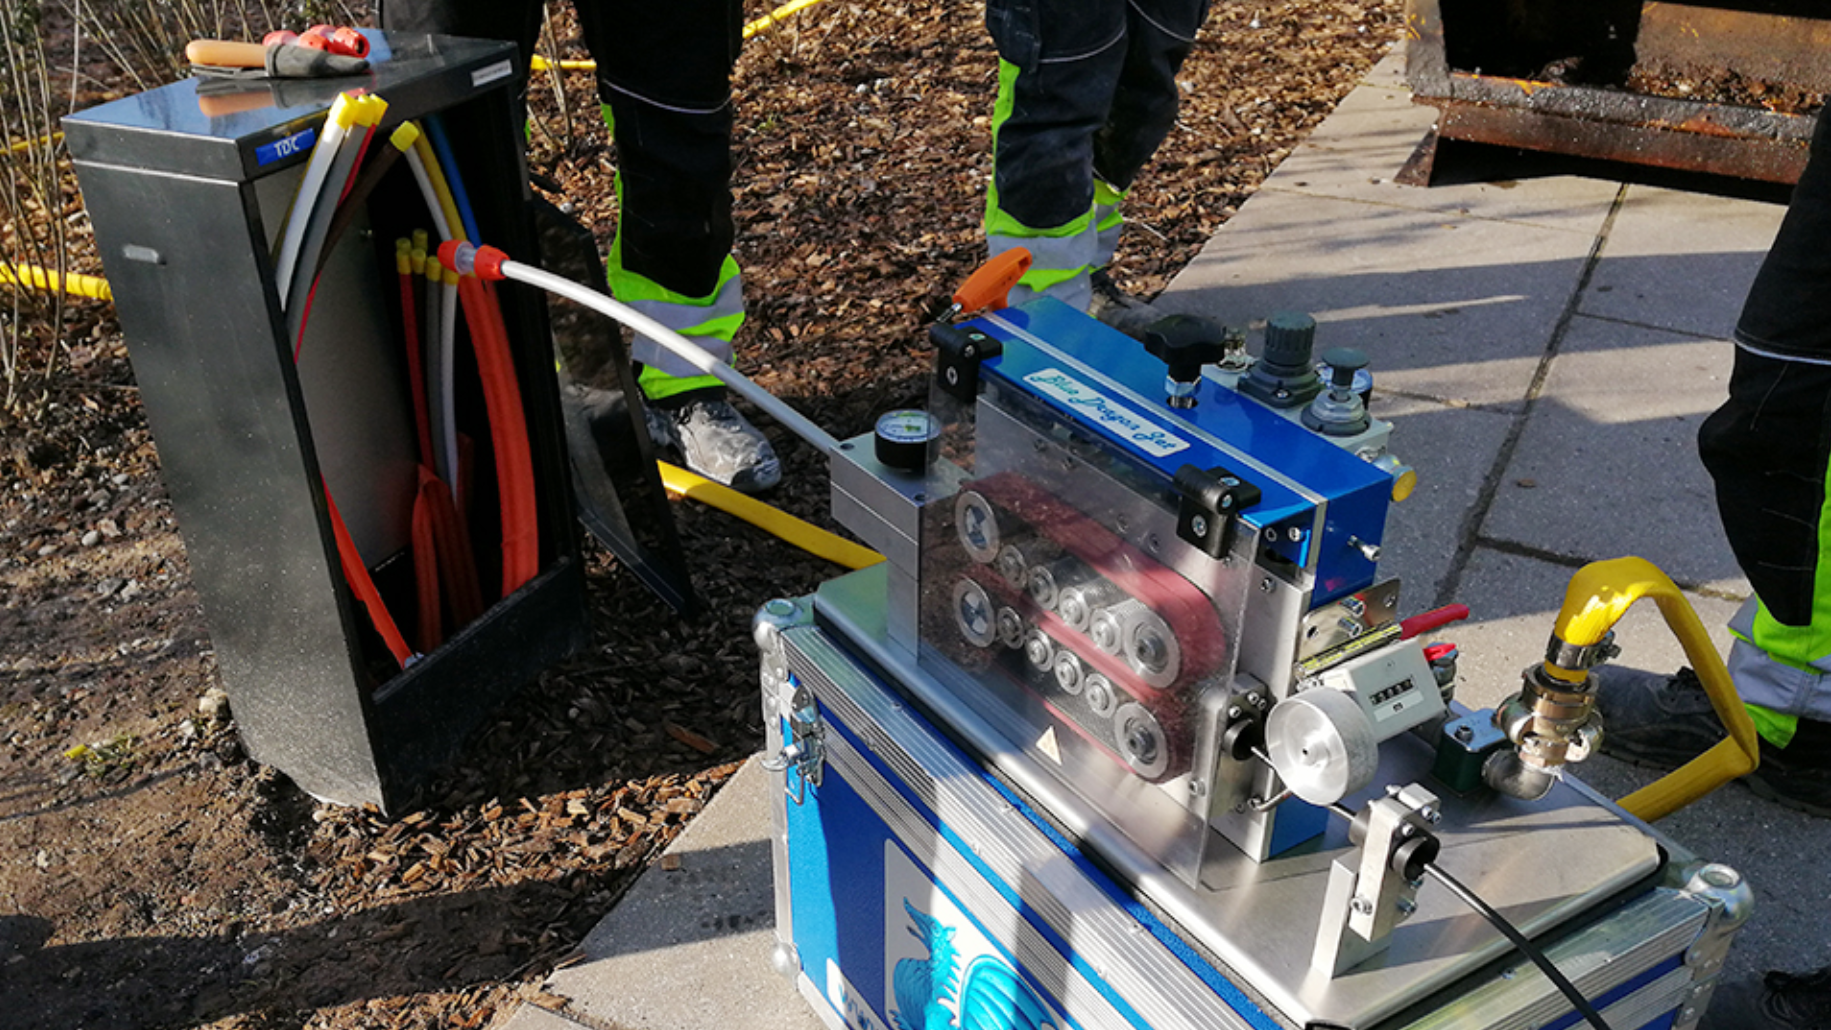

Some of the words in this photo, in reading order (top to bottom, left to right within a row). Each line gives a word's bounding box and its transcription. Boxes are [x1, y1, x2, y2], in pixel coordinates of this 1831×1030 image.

[273, 136, 300, 158] TDC
[1029, 374, 1080, 396] Blue
[1131, 430, 1177, 450] Jet
